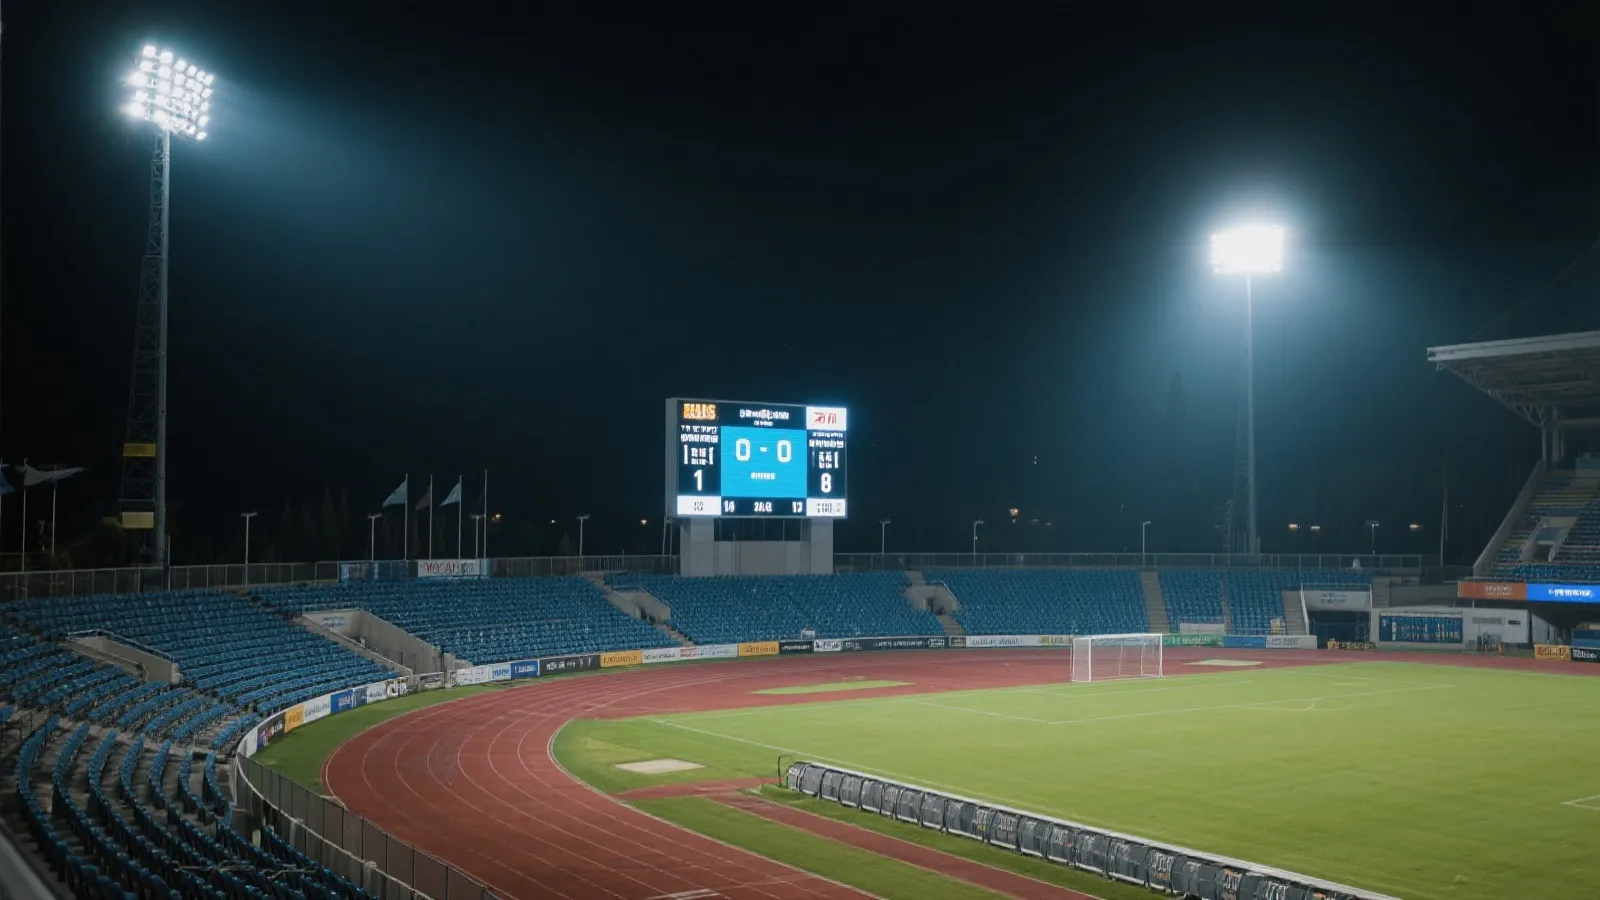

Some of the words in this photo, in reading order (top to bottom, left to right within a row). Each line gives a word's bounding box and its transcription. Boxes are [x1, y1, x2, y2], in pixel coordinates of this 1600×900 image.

[736, 438, 751, 462] 0
[777, 439, 792, 463] 0
[693, 469, 703, 491] 1
[820, 472, 832, 493] 8
